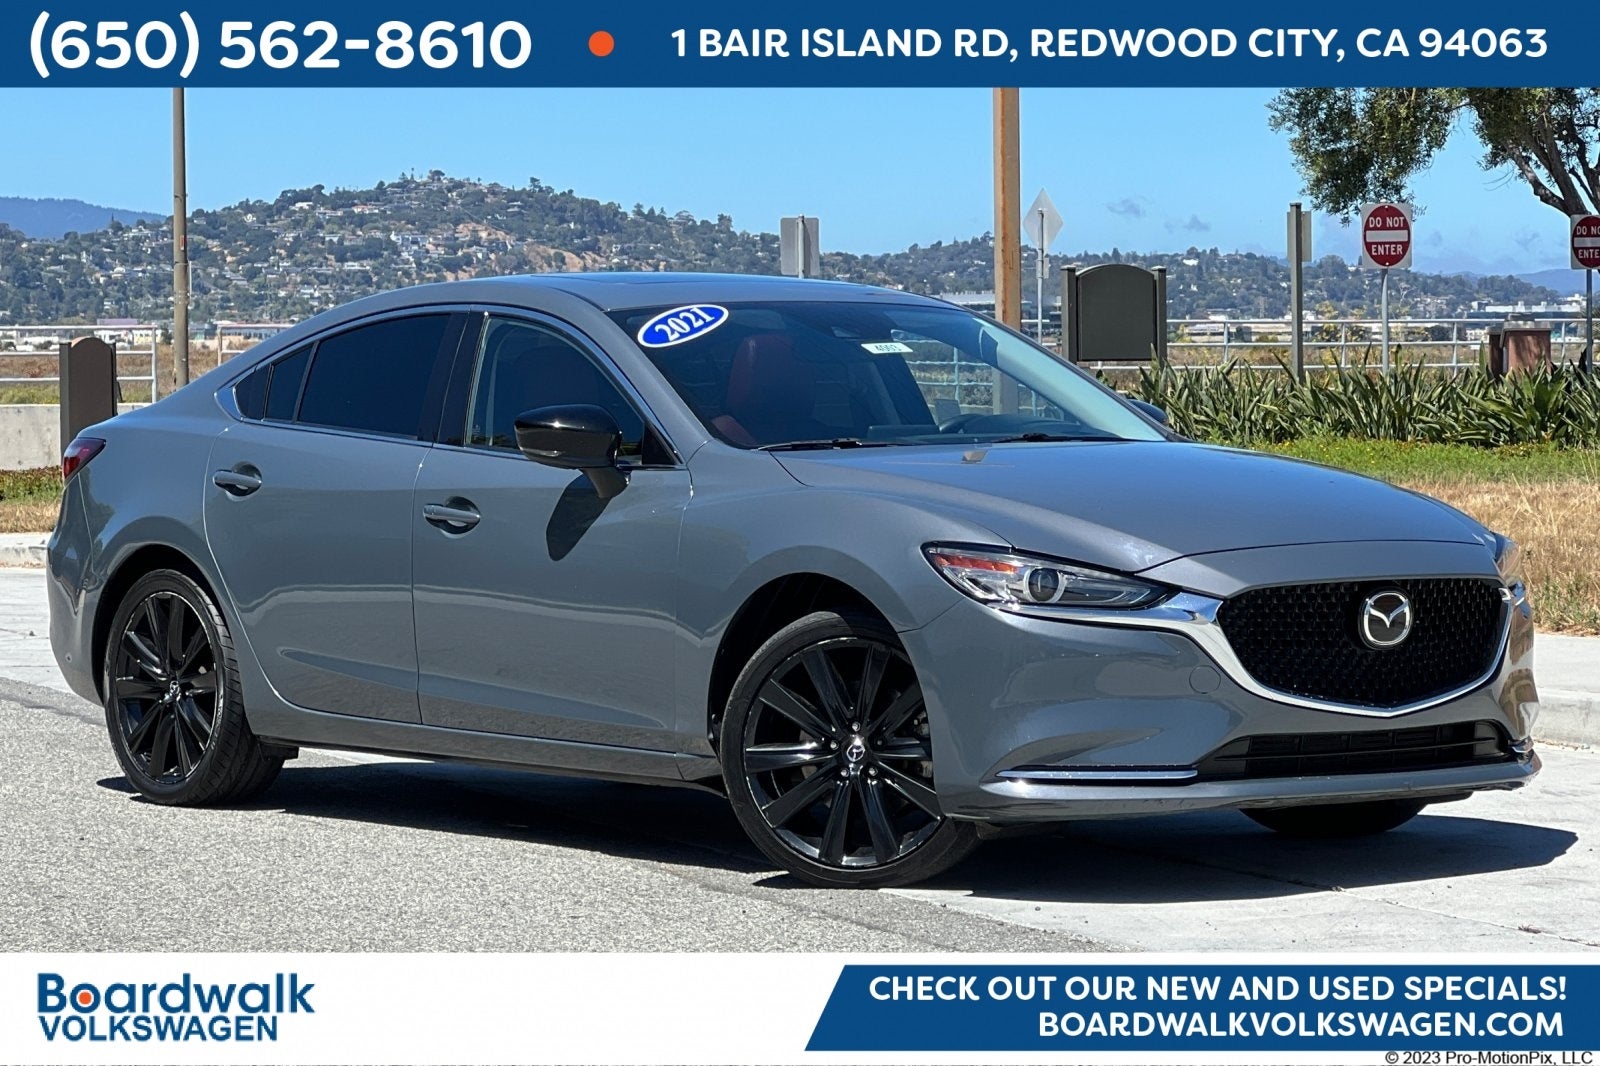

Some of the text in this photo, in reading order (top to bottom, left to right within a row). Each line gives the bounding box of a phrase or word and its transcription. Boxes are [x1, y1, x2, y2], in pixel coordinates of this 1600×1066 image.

[1369, 216, 1404, 228] DO NOT
[1576, 225, 1600, 235] DO NO
[1371, 244, 1403, 256] ENTER
[1578, 249, 1600, 259] ENTE
[654, 307, 715, 342] 2021
